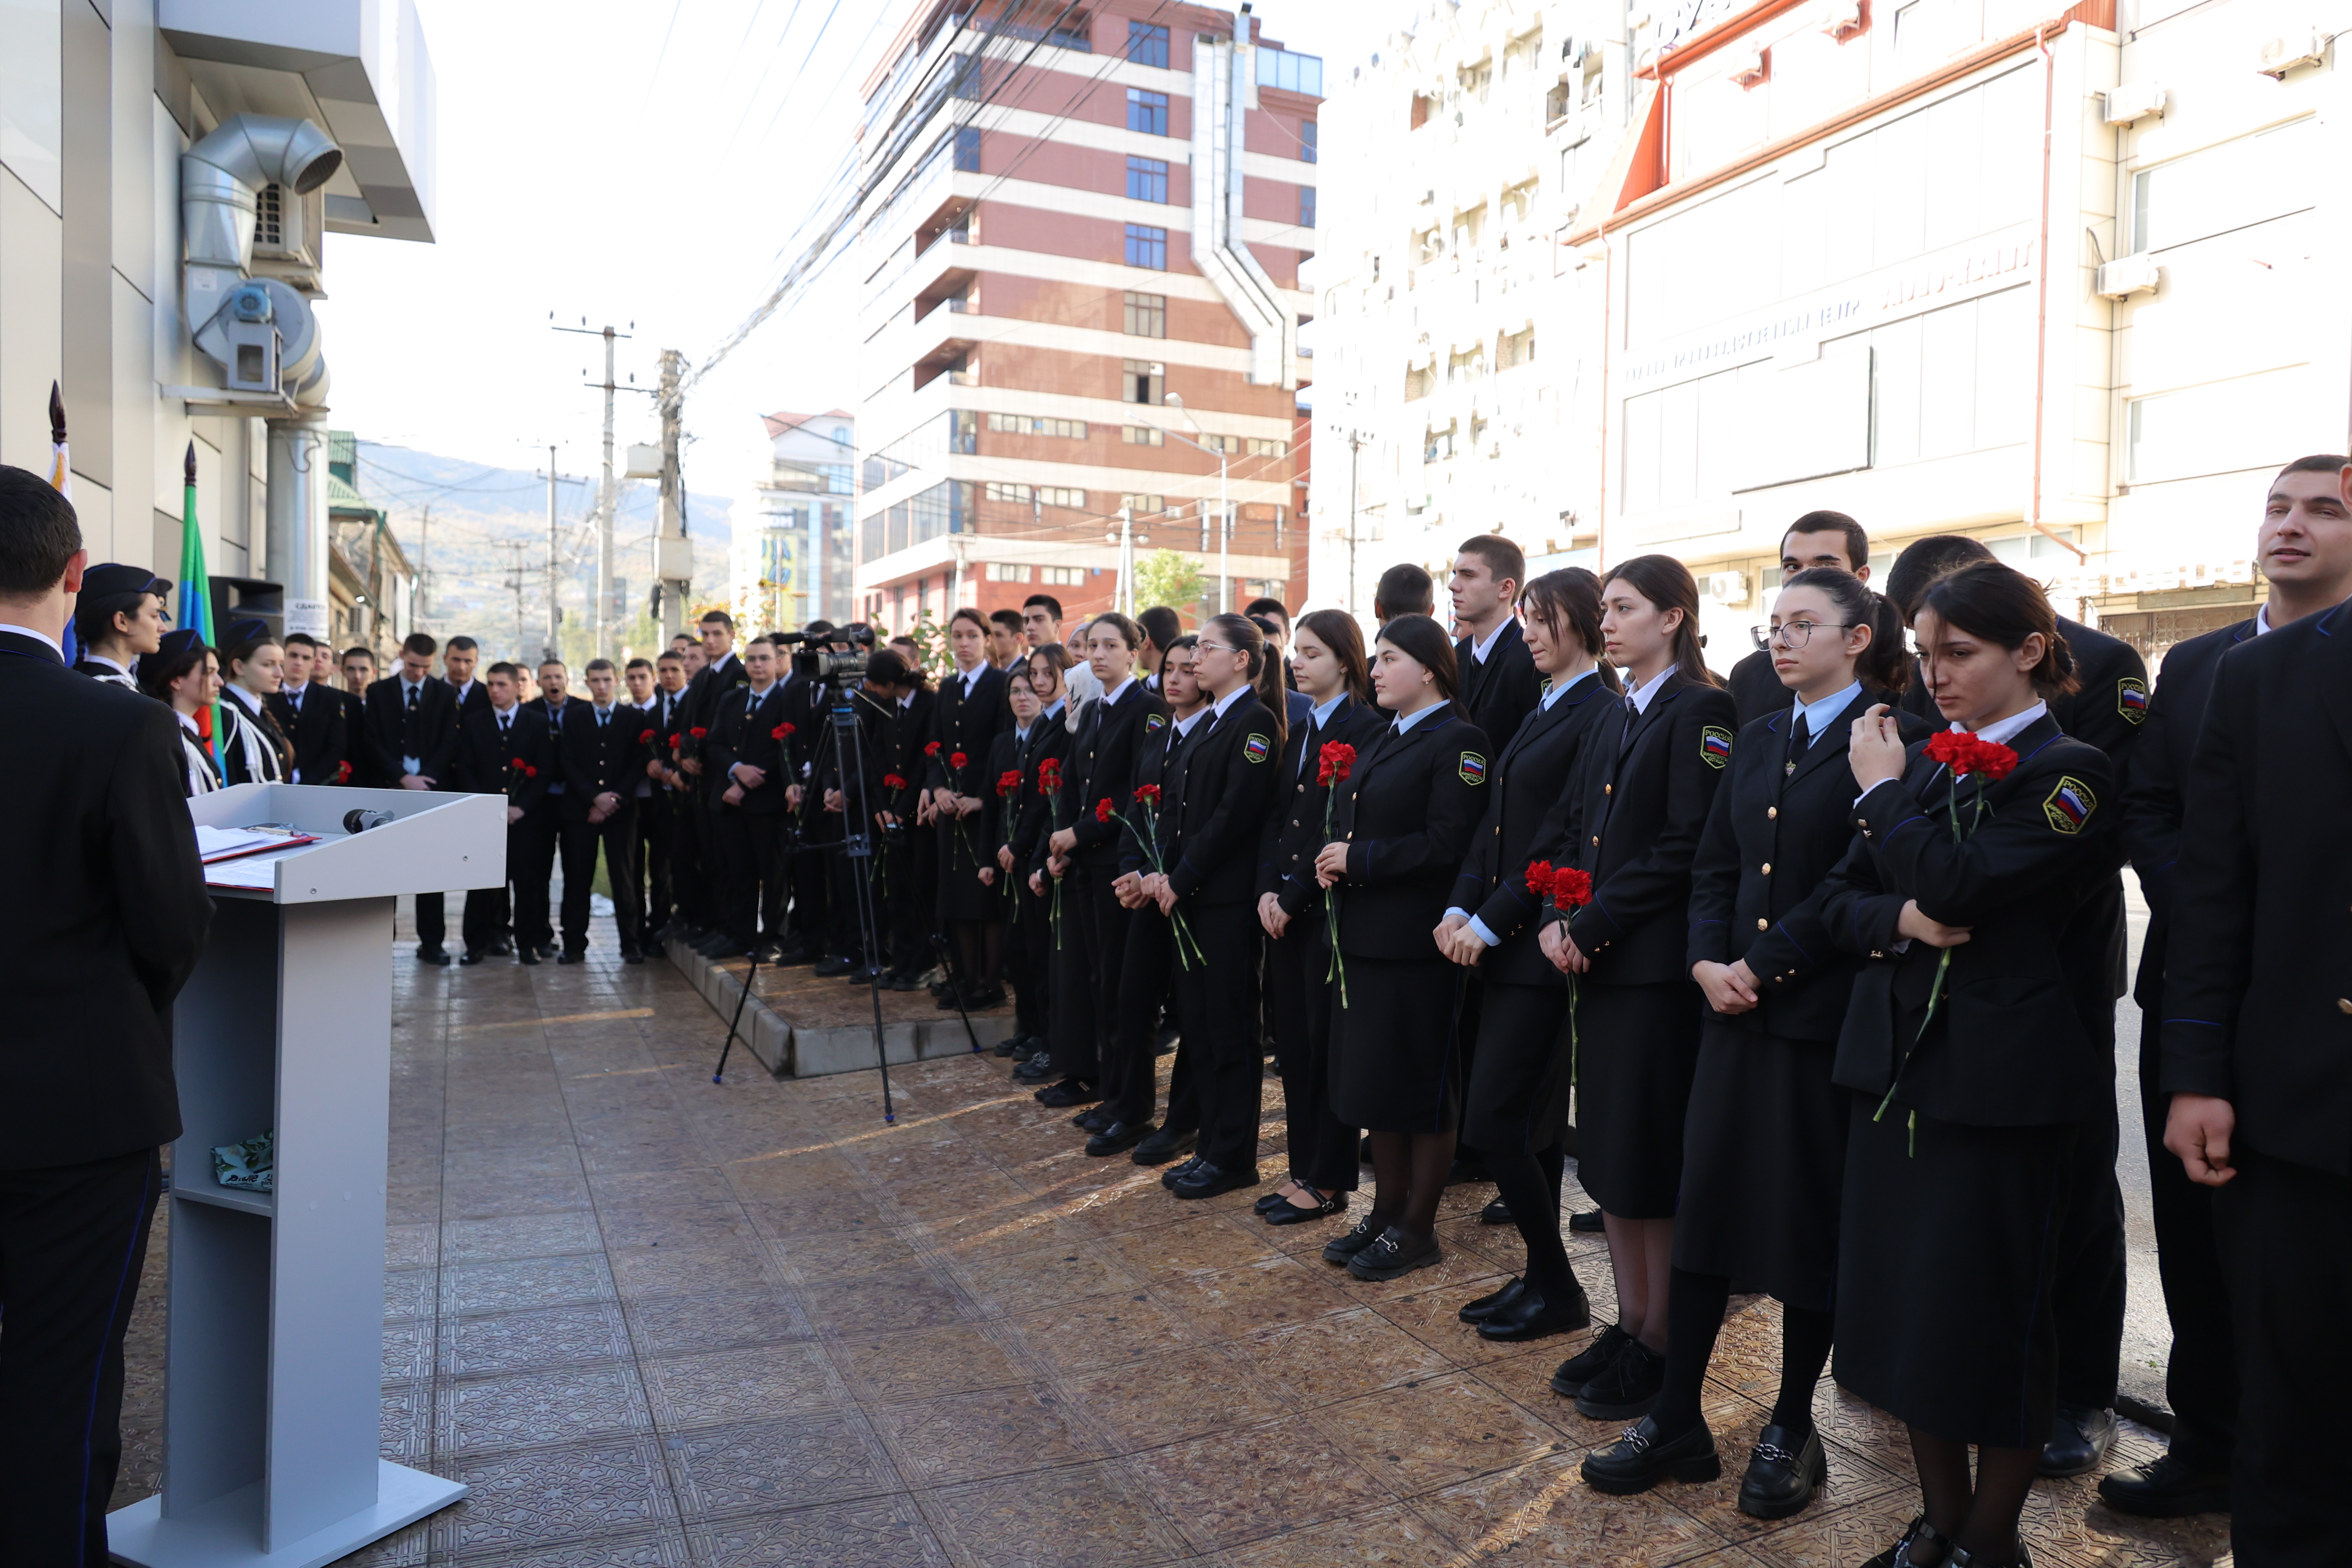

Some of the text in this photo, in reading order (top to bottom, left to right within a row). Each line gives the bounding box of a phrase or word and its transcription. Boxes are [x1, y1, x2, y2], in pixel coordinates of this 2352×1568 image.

[2121, 683, 2146, 693] РОССИЯ
[1250, 736, 1268, 746] РОССИЯ
[1705, 730, 1731, 742] РОССИЯ
[1463, 754, 1485, 765] РОССИЯ
[2063, 780, 2094, 811] РОССИЯ
